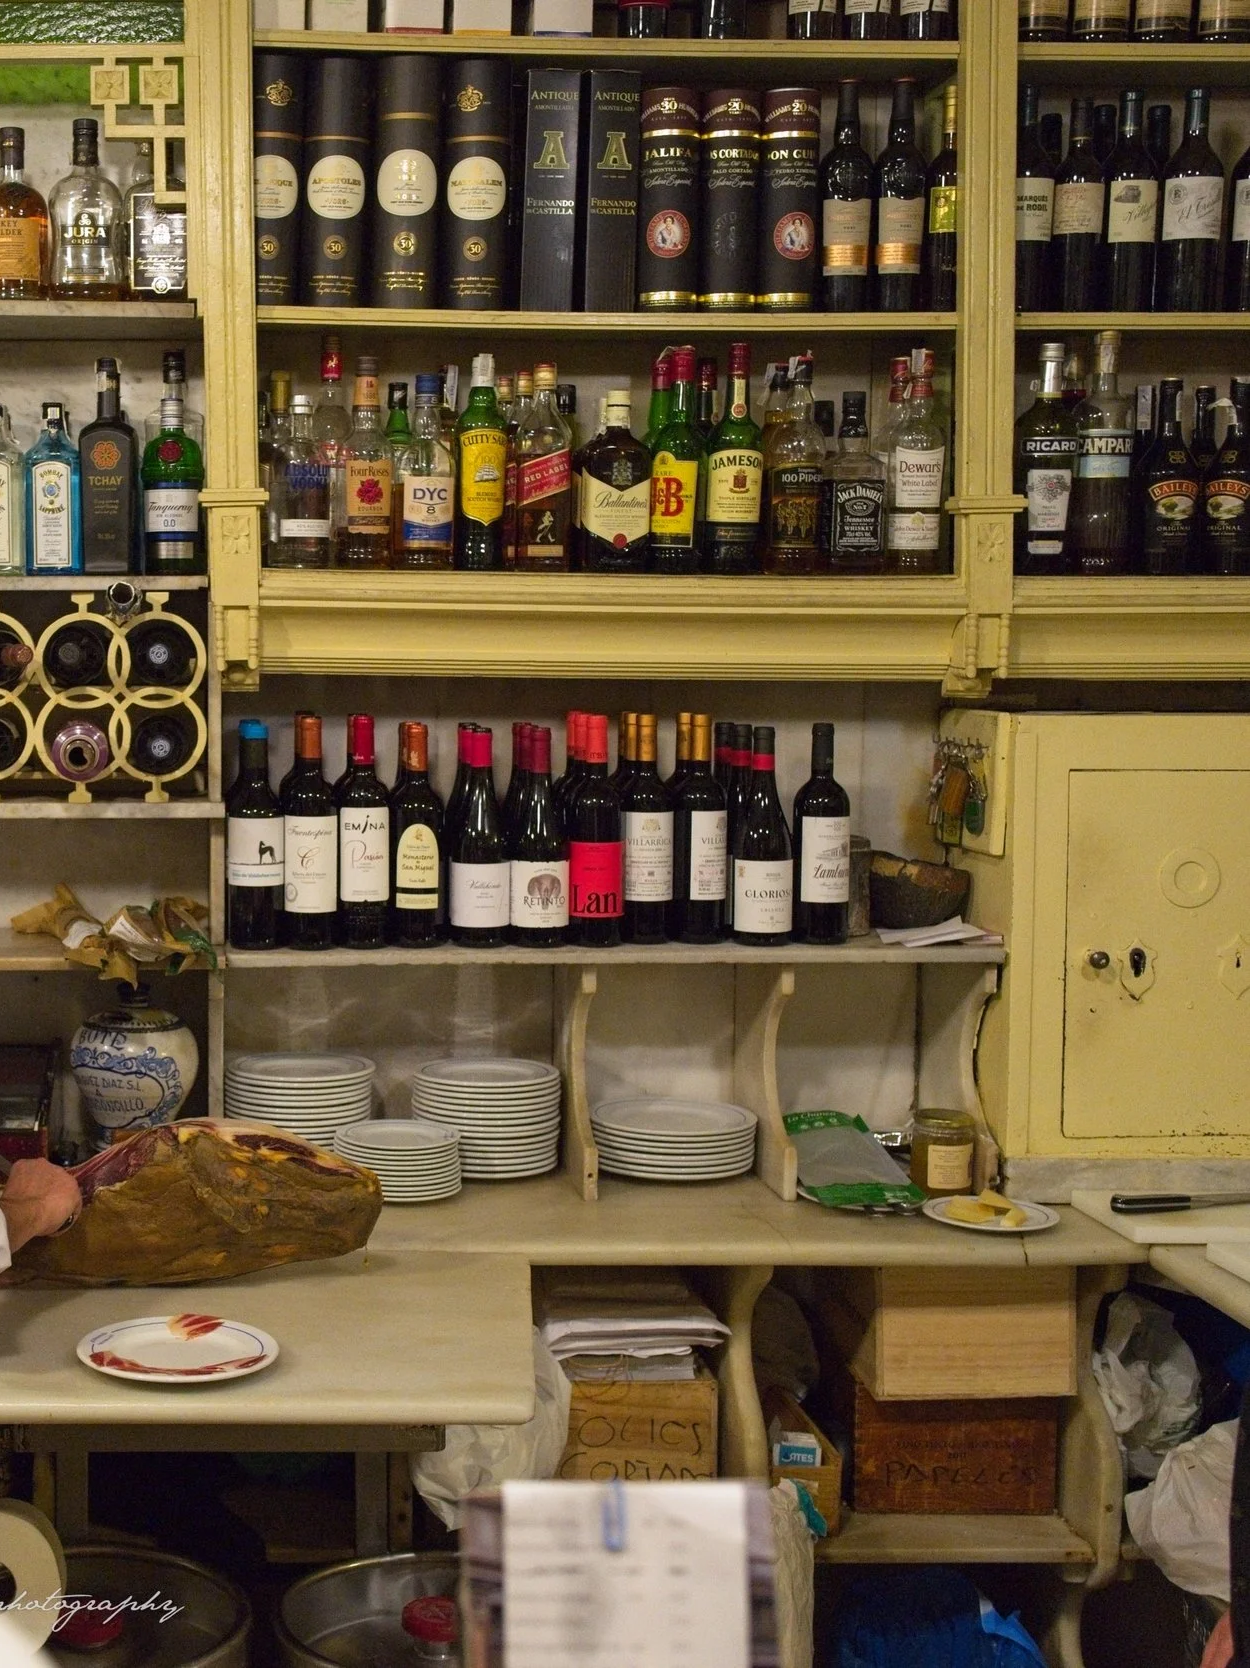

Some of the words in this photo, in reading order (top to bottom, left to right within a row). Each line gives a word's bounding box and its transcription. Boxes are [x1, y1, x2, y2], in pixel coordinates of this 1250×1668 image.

[531, 90, 579, 102] ANTIQUE
[594, 90, 640, 103] ANTIQUE
[660, 100, 678, 110] 30
[728, 101, 744, 110] 20
[792, 101, 807, 112] 20
[533, 130, 570, 169] A
[597, 131, 632, 170] A
[768, 149, 788, 161] ON
[793, 149, 815, 160] GUI
[527, 197, 575, 208] FERNANDO
[591, 197, 636, 208] FERNANDO
[1026, 203, 1048, 212] RODIL
[532, 207, 574, 216] CASTILLA
[596, 207, 636, 216] CASTILLA
[64, 226, 107, 239] JURA
[262, 243, 274, 252] 30
[329, 243, 342, 252] 30
[400, 240, 412, 249] 30
[469, 245, 481, 254] 30
[463, 434, 491, 447] CUTTY
[493, 436, 508, 447] SA
[1026, 441, 1076, 451] RICARD
[284, 463, 329, 477] ABSOLU
[350, 466, 367, 477] Four
[368, 466, 389, 477] Roses
[899, 460, 941, 473] Dewar's
[525, 473, 542, 483] RED
[543, 463, 568, 477] LABEL
[782, 473, 796, 483] 100
[88, 475, 123, 486] TCHAY
[901, 479, 920, 487] White
[1153, 480, 1198, 496] BAILEYS
[1206, 480, 1247, 495] AILEYS
[413, 488, 448, 501] DYC
[593, 491, 647, 509] Ballantine's
[837, 490, 856, 504] JACK
[856, 485, 883, 504] DANIEL'S
[149, 501, 193, 514] Tanqueray
[427, 505, 436, 514] 8
[163, 519, 176, 528] 0.0
[844, 515, 875, 523] Tennessee
[402, 863, 415, 871] San
[524, 895, 566, 909] RETINTO
[573, 884, 618, 914] Lan
